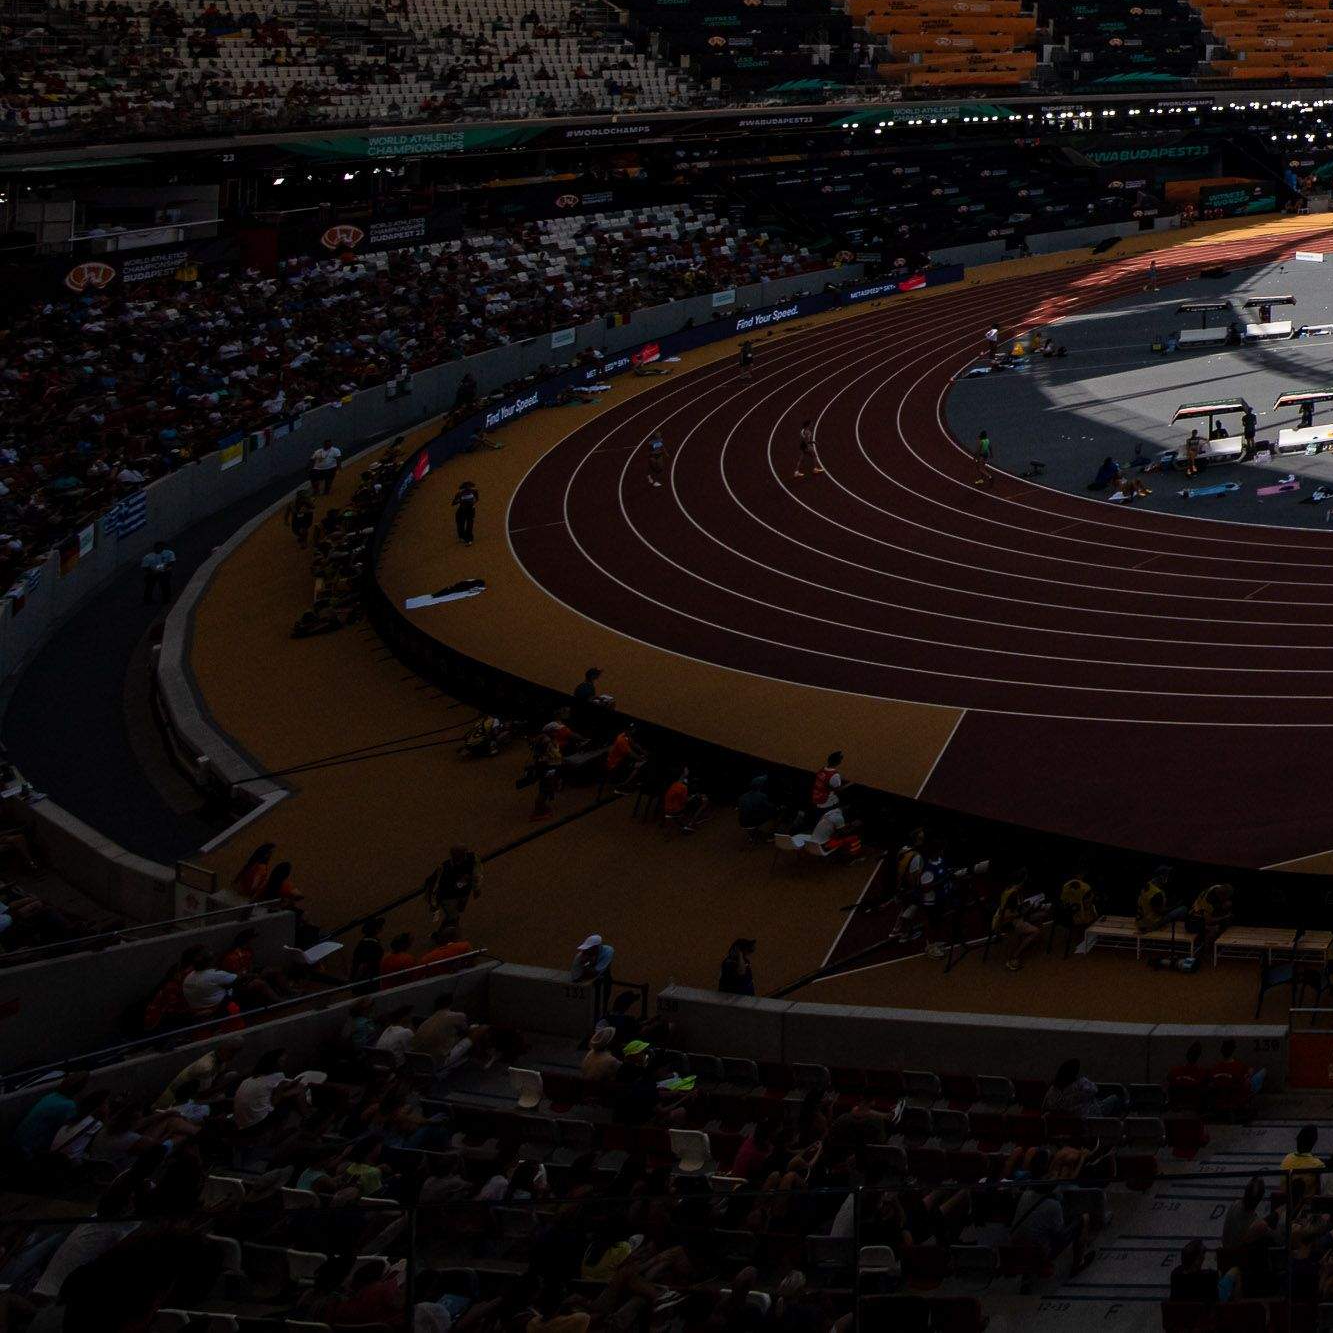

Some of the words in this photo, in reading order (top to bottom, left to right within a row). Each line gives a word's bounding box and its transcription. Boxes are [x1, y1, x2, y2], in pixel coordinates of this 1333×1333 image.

[738, 116, 814, 127] #WABUDAPEST23
[369, 136, 408, 147] WORLD
[410, 131, 465, 144] ATHLETICS
[565, 125, 652, 139] #WORLDCHAMPS
[369, 140, 465, 156] CHAMPIONSHIPS
[736, 317, 754, 331] Find
[755, 312, 773, 327] Your
[486, 407, 502, 428] Find
[501, 400, 518, 421] Your
